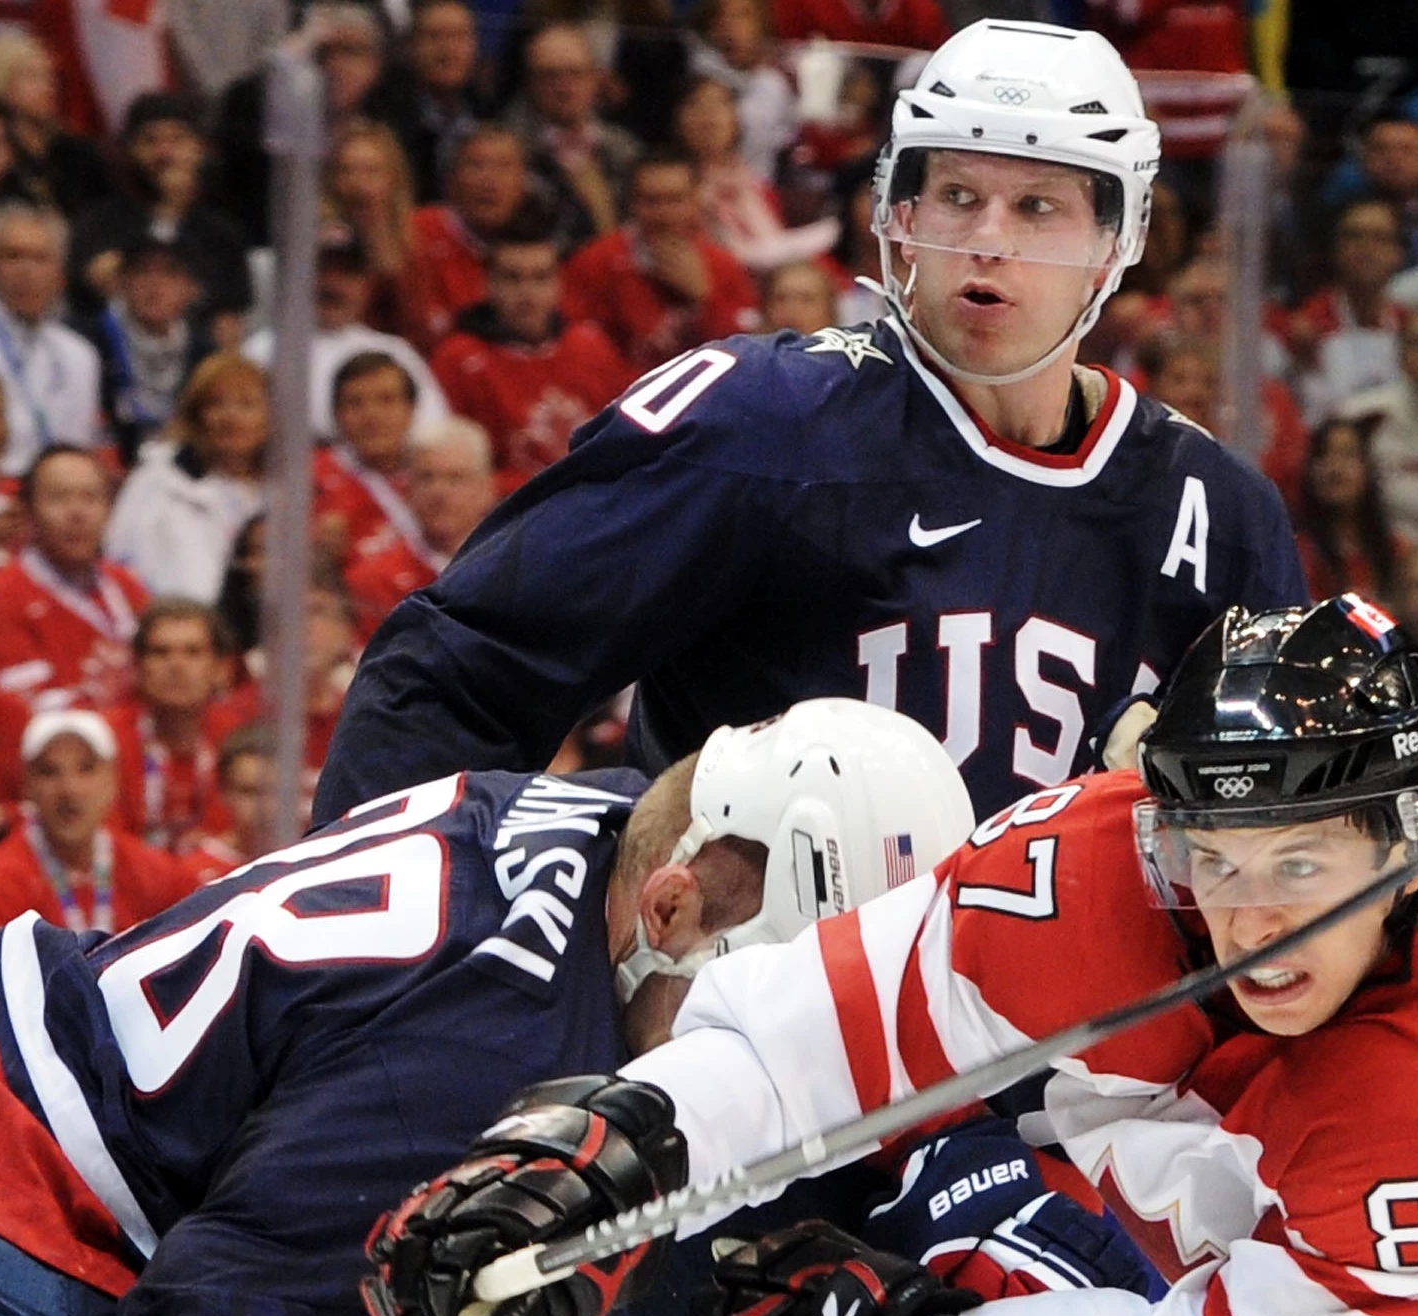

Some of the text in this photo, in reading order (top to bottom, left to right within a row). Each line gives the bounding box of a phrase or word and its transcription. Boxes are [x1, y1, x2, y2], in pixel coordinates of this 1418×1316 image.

[619, 346, 739, 434] 0
[1160, 475, 1210, 595] A
[856, 610, 1163, 790] US
[953, 782, 1085, 922] 87
